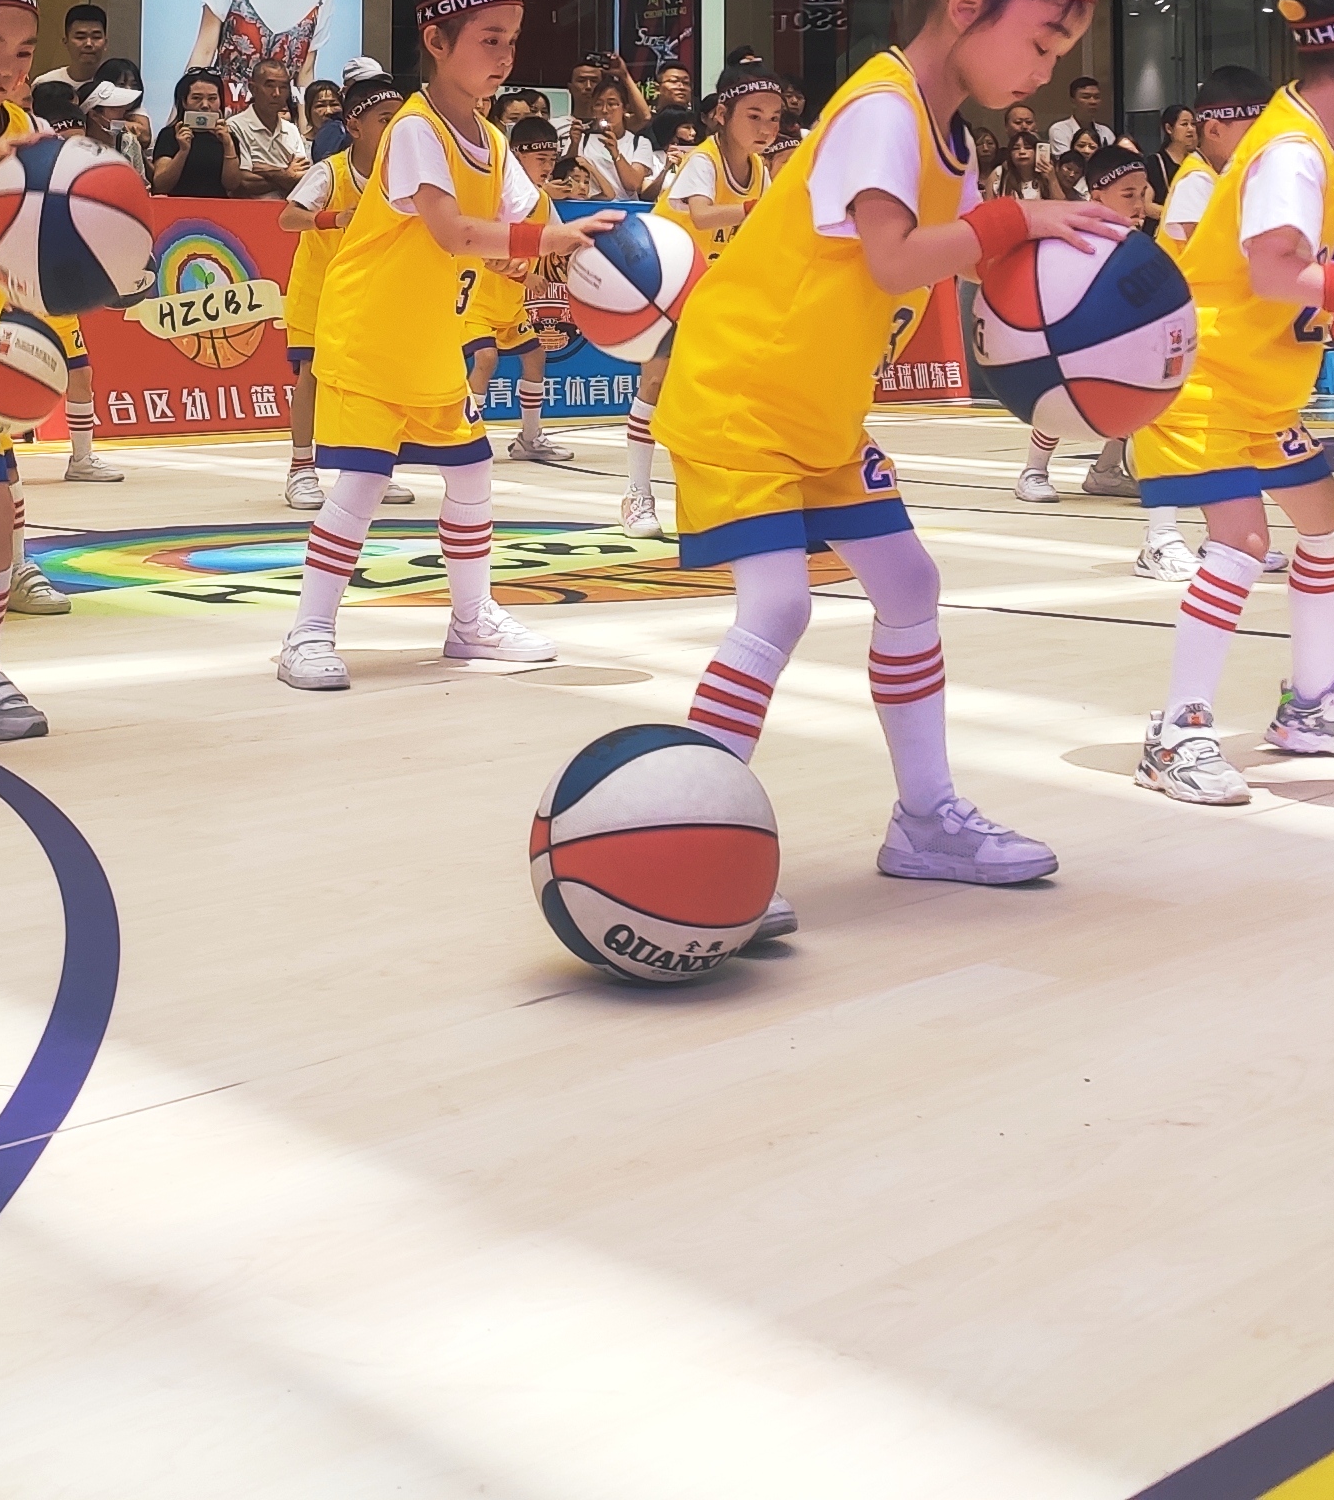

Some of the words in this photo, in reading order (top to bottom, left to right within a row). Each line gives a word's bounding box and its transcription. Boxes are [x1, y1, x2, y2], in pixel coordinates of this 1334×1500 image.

[159, 283, 265, 333] HZCBL
[483, 374, 642, 408] 青年体育俱
[871, 361, 963, 392] 篮球训练营
[93, 385, 296, 427] 台区幼儿篮
